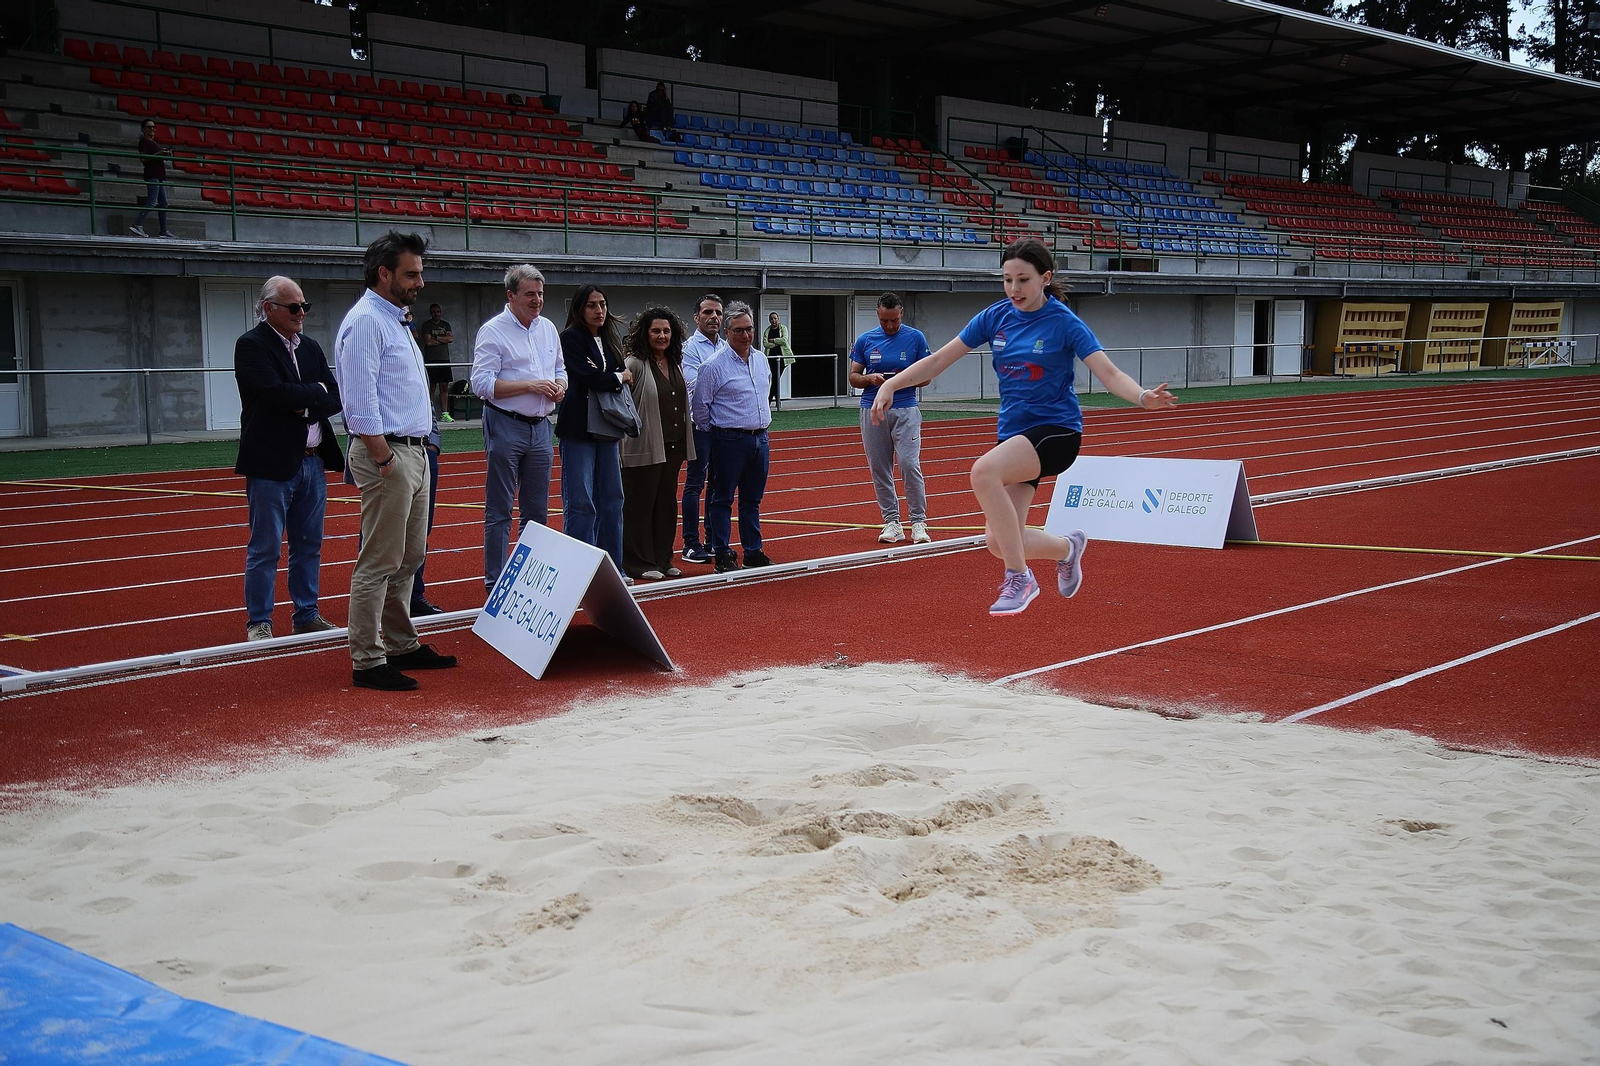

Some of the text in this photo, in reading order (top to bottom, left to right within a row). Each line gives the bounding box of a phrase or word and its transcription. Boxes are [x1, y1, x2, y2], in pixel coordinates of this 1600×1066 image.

[1084, 488, 1117, 498] XUNTA
[1169, 491, 1213, 503] DEPORTE
[1082, 498, 1134, 510] DE GALICIA
[1167, 504, 1207, 515] GALEGO
[520, 558, 559, 597] XUNTA
[502, 589, 562, 646] DE GALICIA
